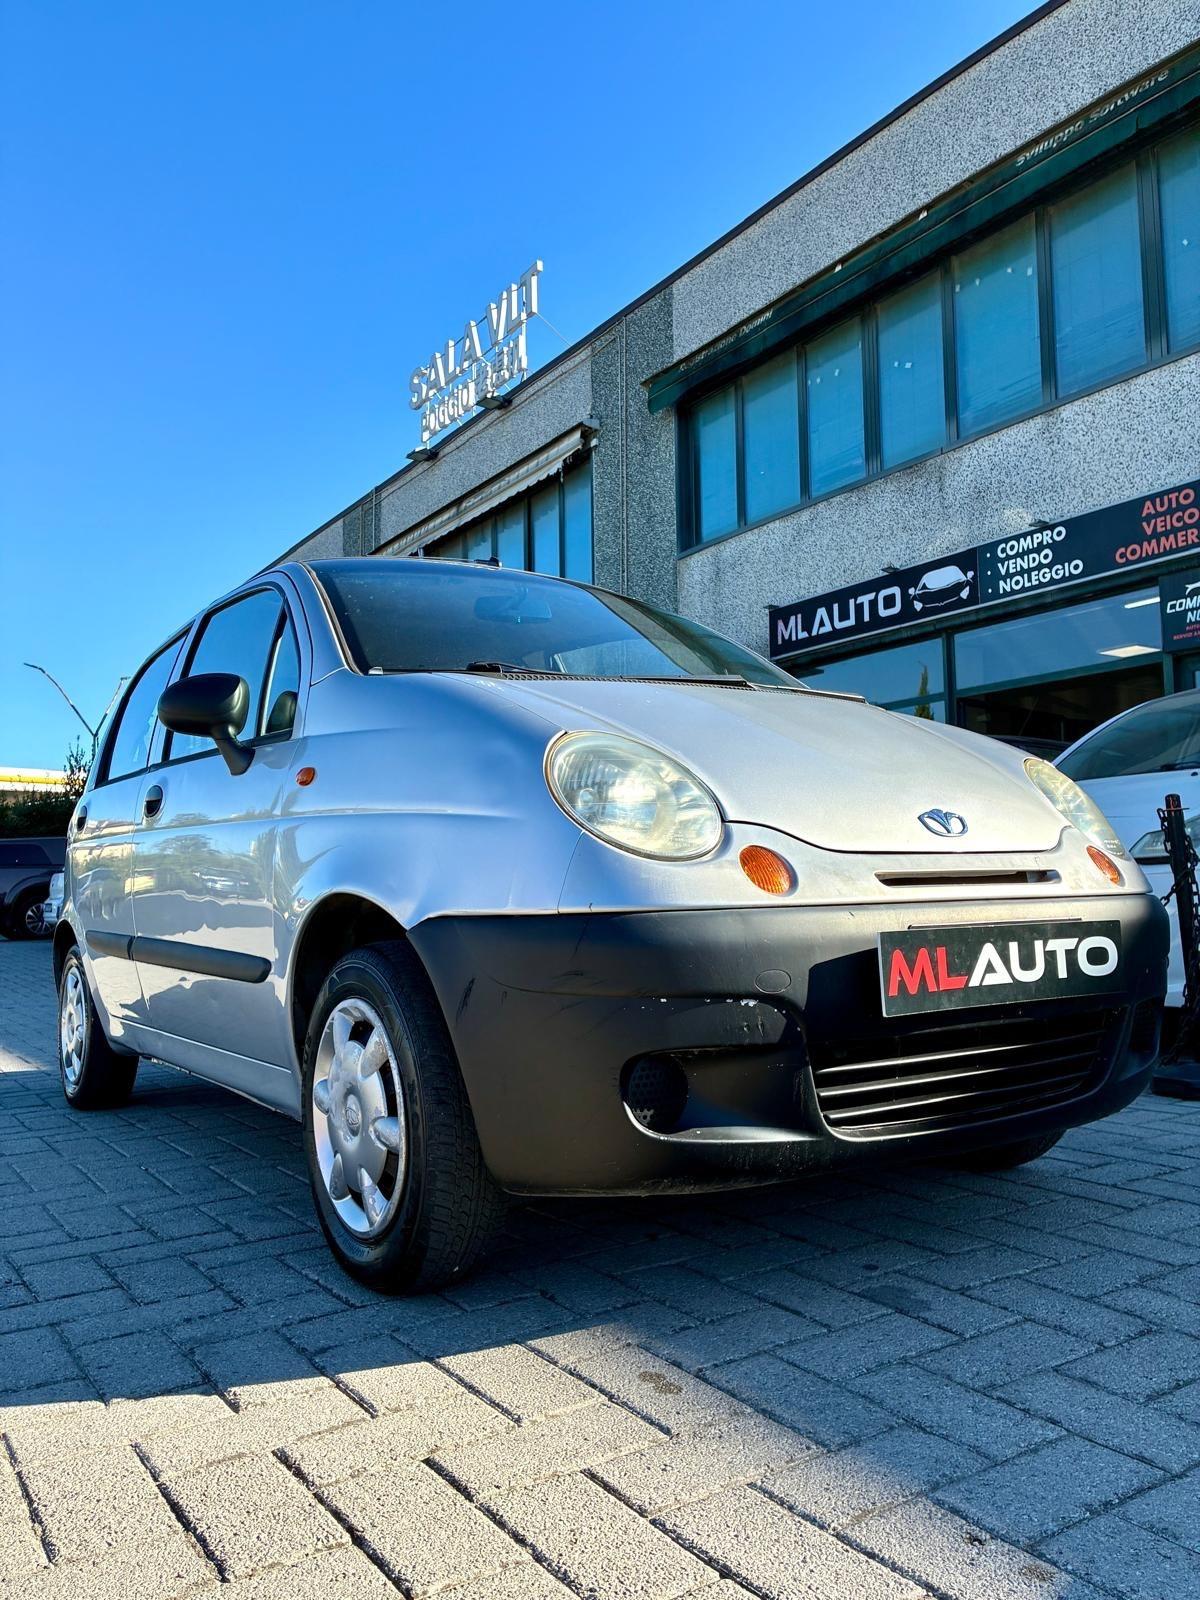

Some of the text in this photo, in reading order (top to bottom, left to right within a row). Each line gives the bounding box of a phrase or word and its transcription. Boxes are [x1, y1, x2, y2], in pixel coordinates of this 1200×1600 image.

[1015, 69, 1169, 166] Sviluppo Software
[408, 319, 483, 410] SALA
[1141, 488, 1195, 517] AUTO
[1142, 507, 1200, 535] VEICO
[997, 525, 1066, 558] COMPRO
[1115, 528, 1200, 564] COMMER
[997, 548, 1053, 576] VENDO
[999, 559, 1084, 594] NOLEGGIO
